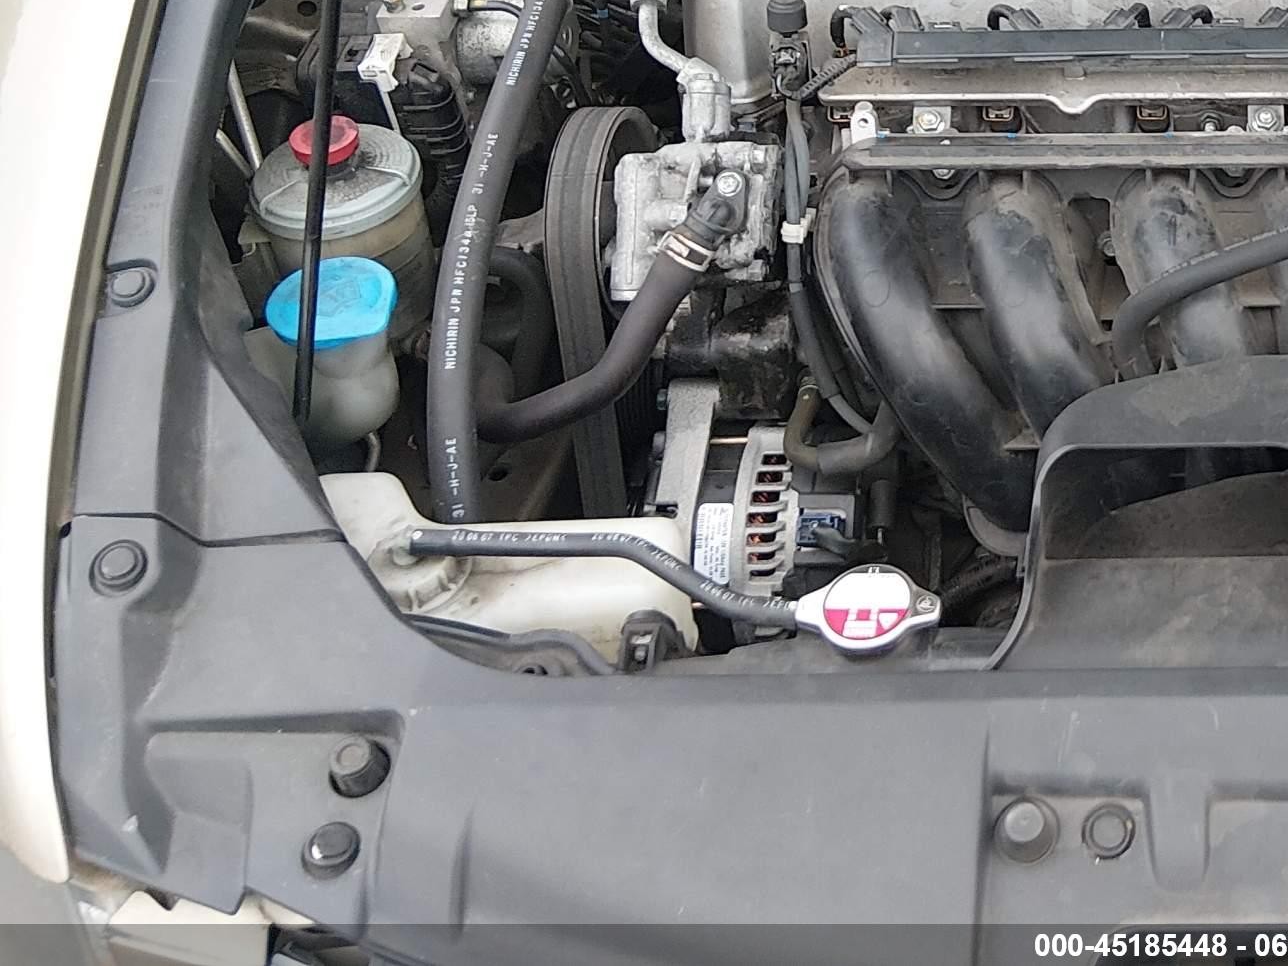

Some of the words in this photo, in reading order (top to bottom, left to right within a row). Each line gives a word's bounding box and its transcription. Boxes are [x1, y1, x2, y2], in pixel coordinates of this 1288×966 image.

[505, 50, 527, 86] NICHIRIN
[520, 32, 533, 49] JPN
[449, 288, 463, 313] JPN
[444, 317, 460, 370] NICHIRIN
